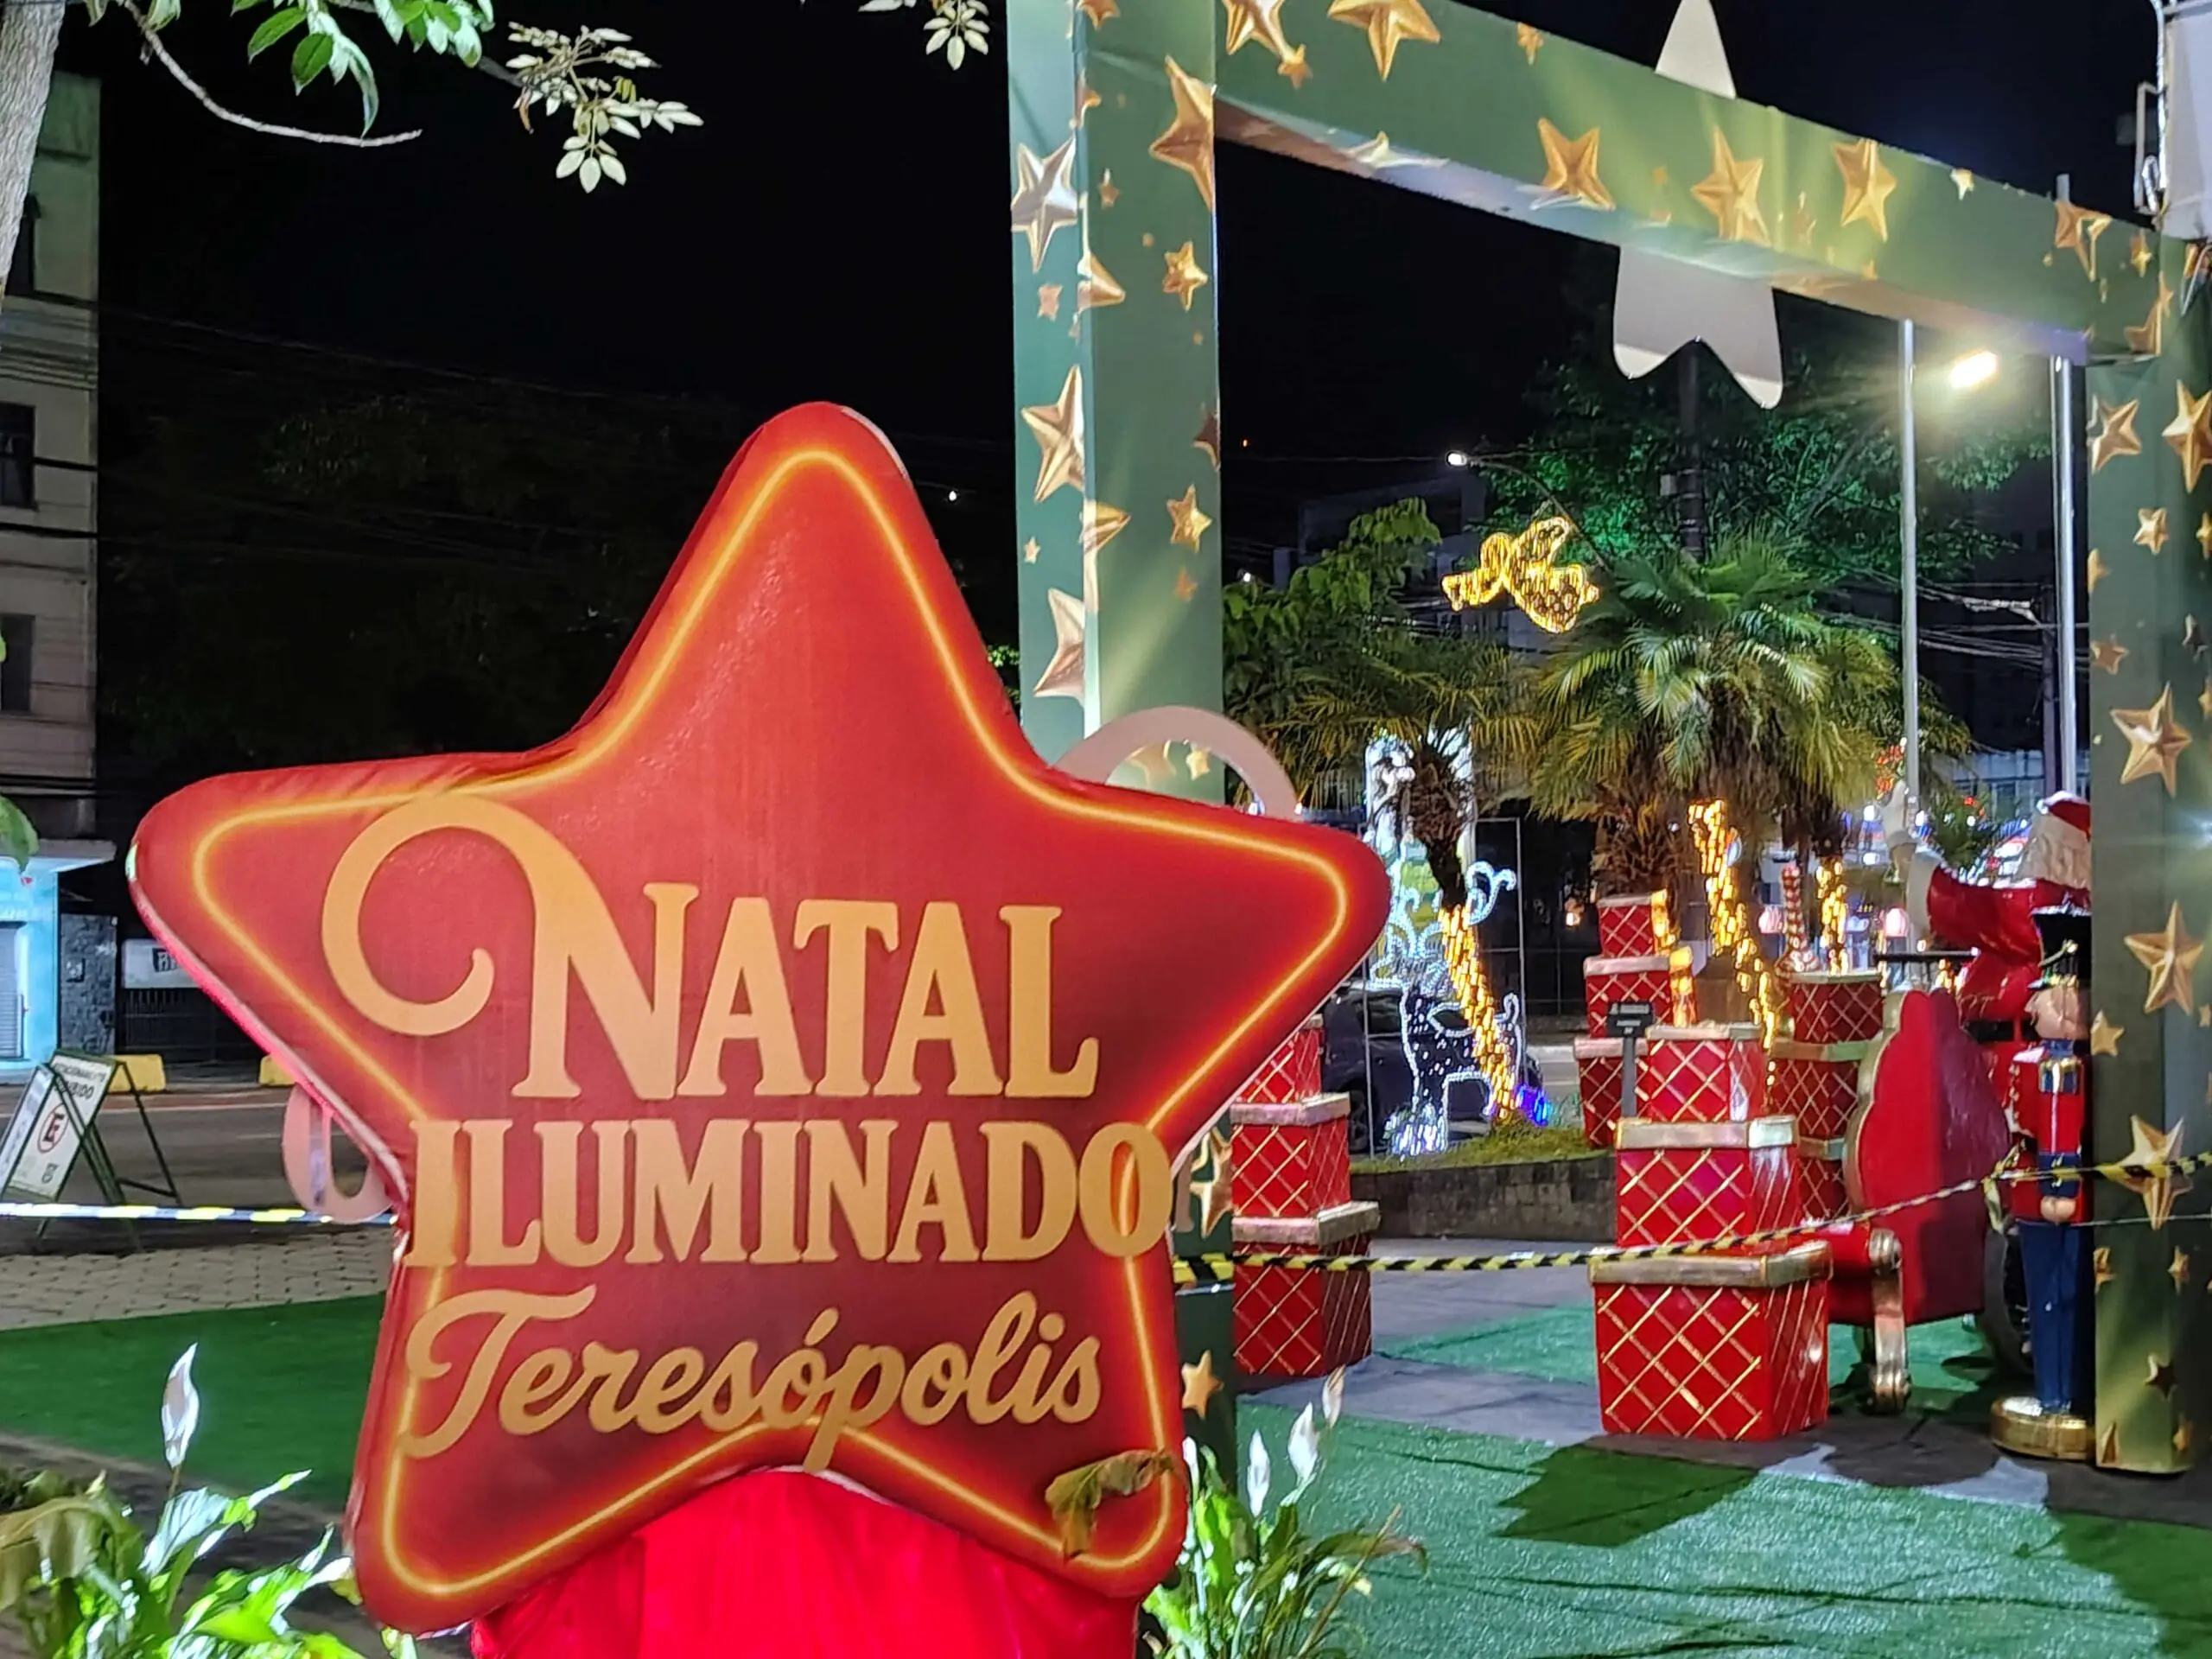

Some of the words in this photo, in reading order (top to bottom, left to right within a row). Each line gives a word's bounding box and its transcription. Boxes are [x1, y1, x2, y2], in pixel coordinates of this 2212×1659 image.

[321, 796, 1099, 1100] NATAL
[405, 1118, 1173, 1267] ILUMINADO
[403, 1284, 1103, 1473] Teresópolis
